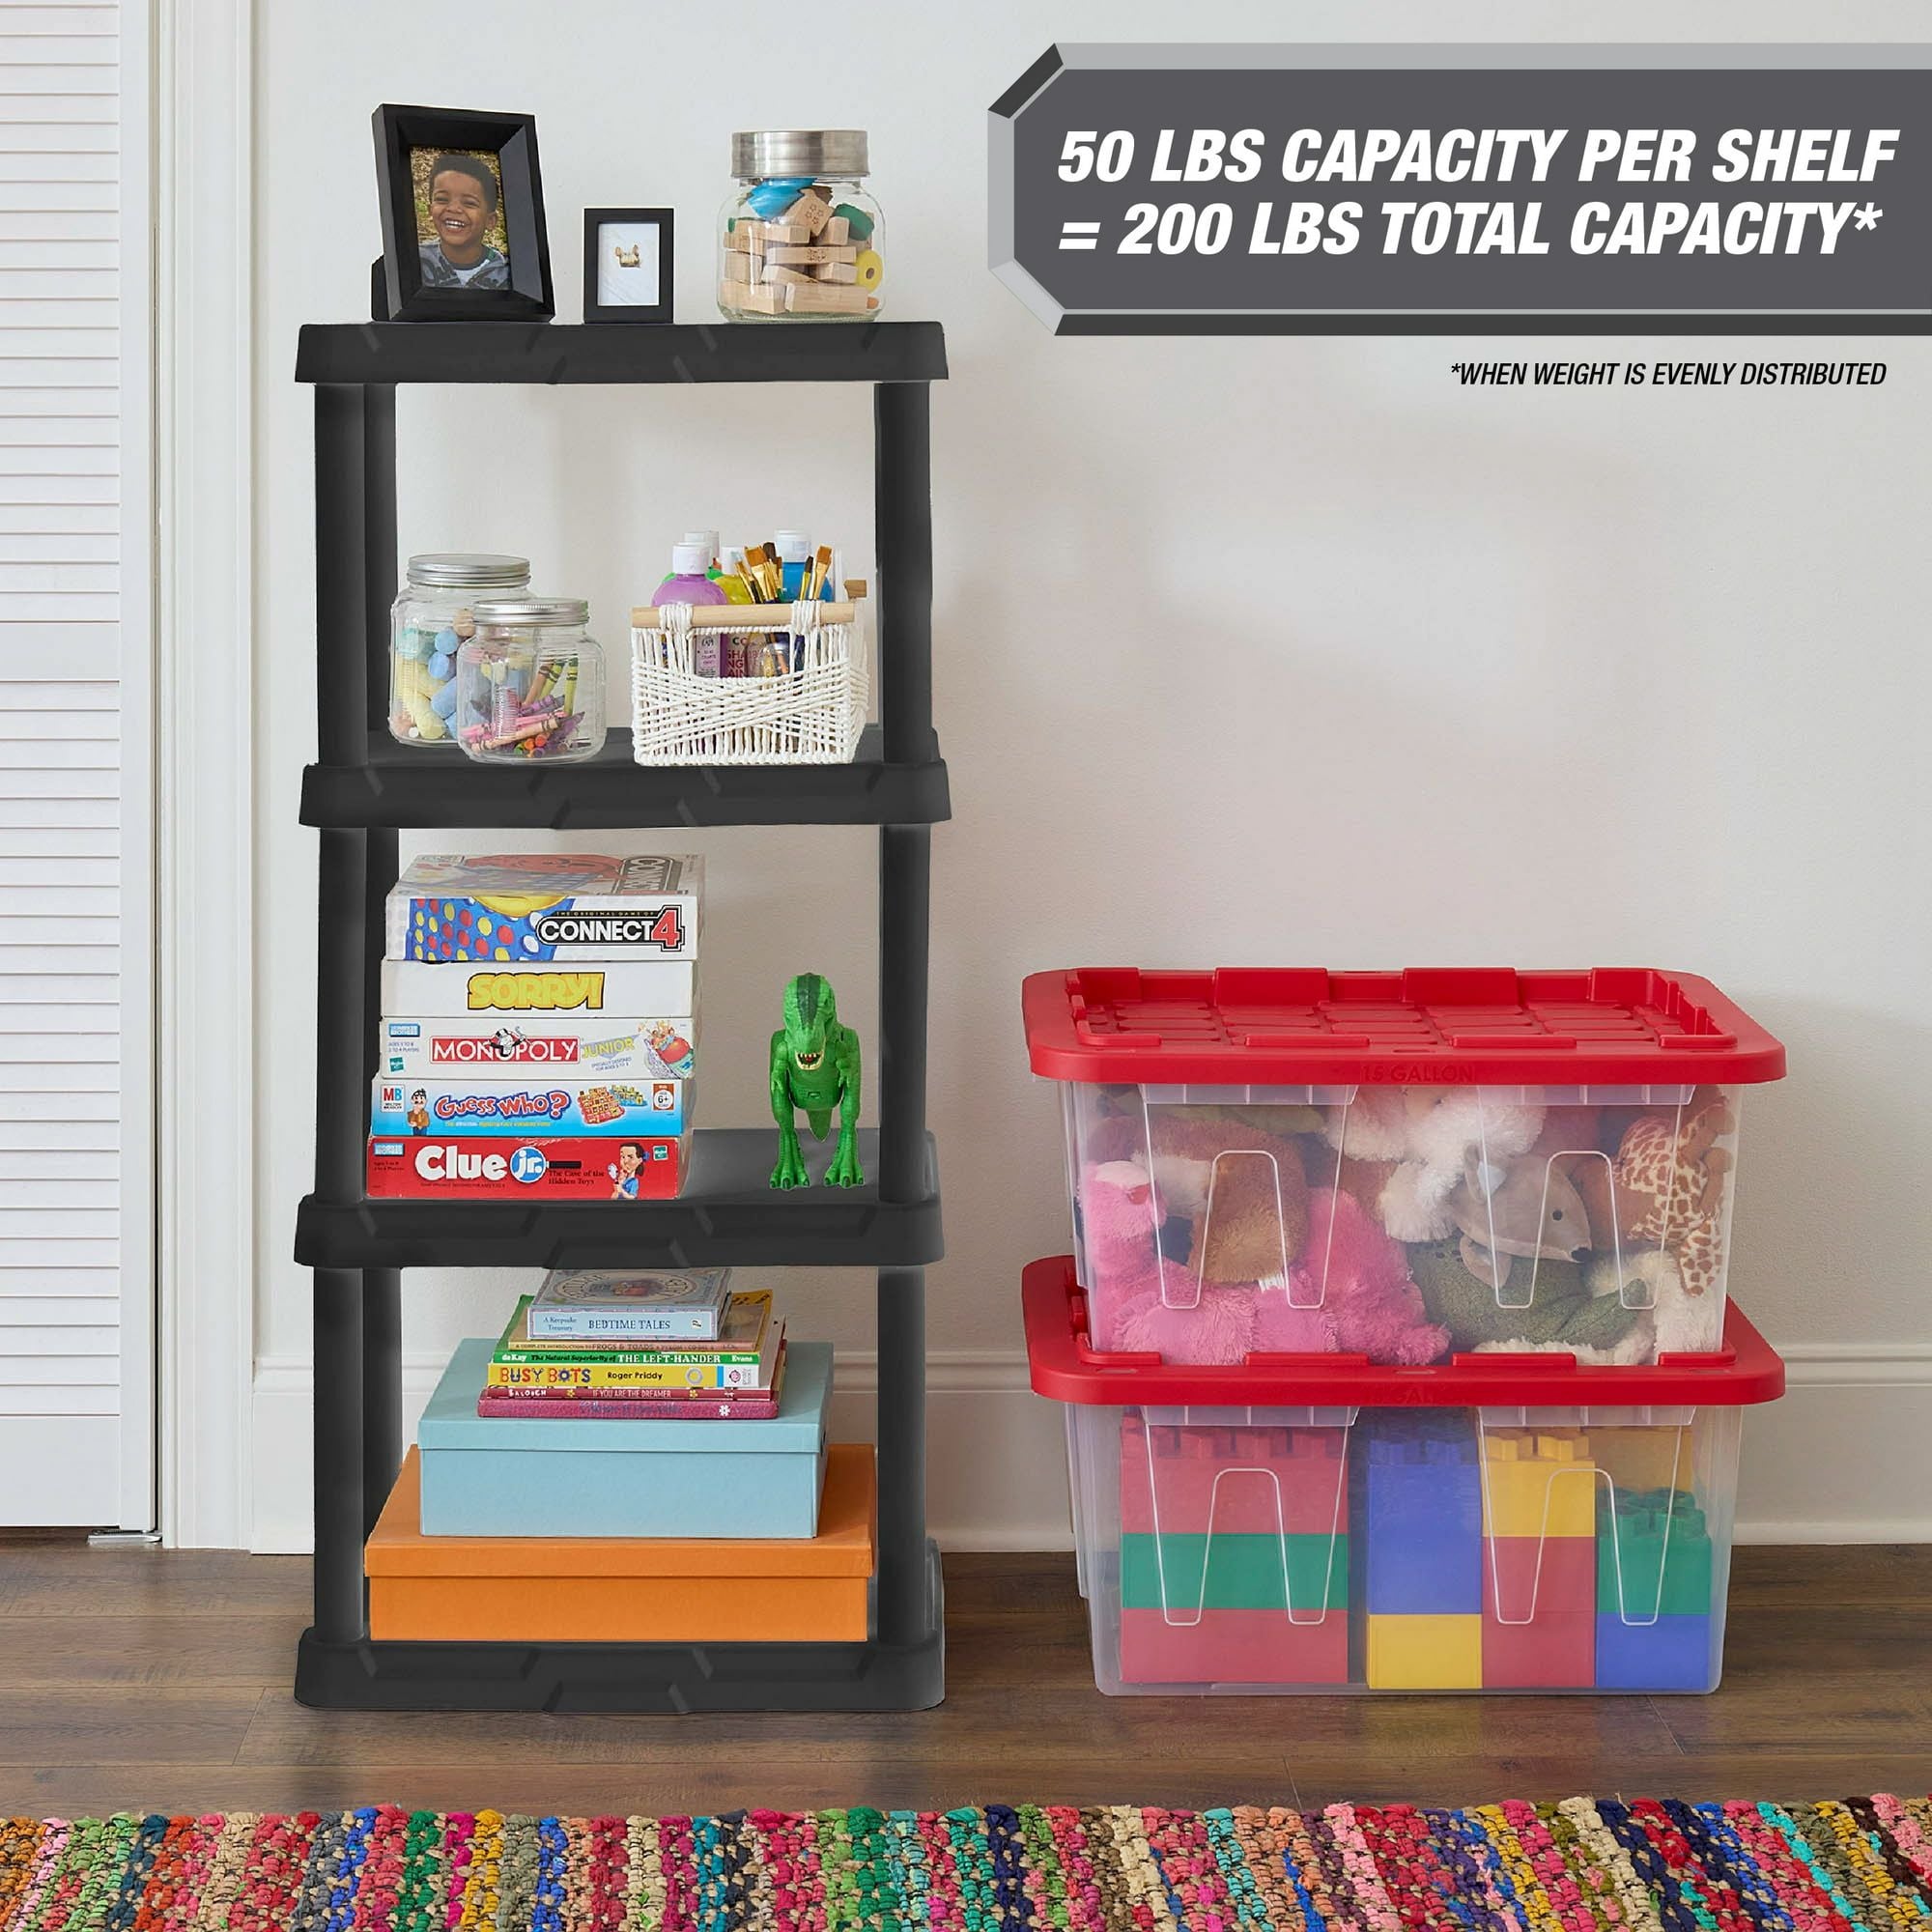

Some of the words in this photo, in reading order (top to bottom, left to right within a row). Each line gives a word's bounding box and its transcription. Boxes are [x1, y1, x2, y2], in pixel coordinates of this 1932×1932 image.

[540, 920, 654, 942] CONNECT
[651, 909, 680, 948] 4
[468, 972, 605, 1009] SORRY!
[433, 1039, 579, 1062] MONOPOLY
[582, 1036, 635, 1060] JUNIOR
[1363, 1065, 1384, 1082] 15
[1390, 1065, 1475, 1082] GALLON
[384, 1088, 403, 1101] MB
[658, 1094, 669, 1104] 6+
[414, 1145, 507, 1180] Clue
[578, 1178, 594, 1186] Toys
[588, 1320, 637, 1329] BEDTIME
[639, 1320, 671, 1329] TALES
[617, 1354, 640, 1363] THE
[500, 1367, 544, 1382] BUSY
[549, 1368, 591, 1382] BOTS
[608, 1371, 633, 1380] Roger
[634, 1371, 664, 1380] Priddy
[600, 1389, 613, 1398] YOU
[614, 1389, 627, 1398] ARE
[628, 1389, 640, 1398] THE
[641, 1389, 671, 1398] DREAMER
